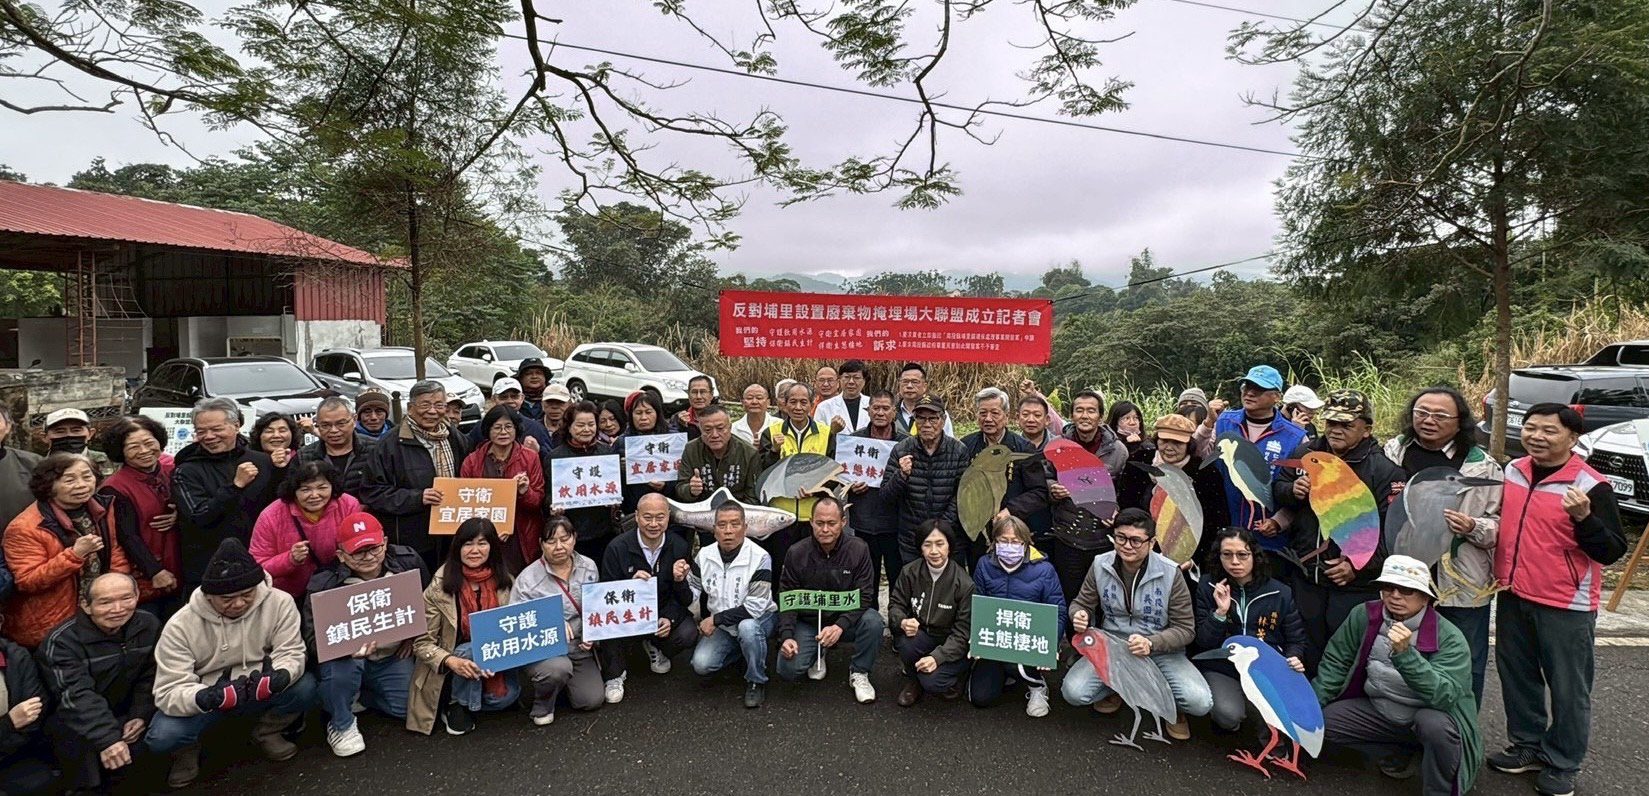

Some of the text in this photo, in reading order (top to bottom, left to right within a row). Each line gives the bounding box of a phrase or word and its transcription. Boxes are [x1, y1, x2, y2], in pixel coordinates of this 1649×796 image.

[733, 302, 1042, 326] 反對埔里設置廢棄物掩埋場大聯盟成立記者會
[735, 326, 759, 335] 我們的
[769, 327, 813, 337] 守護飲用水源
[866, 329, 889, 338] 我們的
[743, 336, 767, 348] 堅持
[873, 339, 897, 351] 訴求
[645, 441, 670, 455] 守衛
[854, 443, 880, 459] 捍衛
[572, 465, 602, 480] 守護
[458, 487, 493, 504] 守衛
[558, 480, 618, 498] 飲用水源
[438, 505, 507, 523] 宜居家園
[353, 521, 366, 533] N
[346, 587, 391, 616] 保衛
[604, 588, 636, 605] 保衛
[784, 592, 856, 607] 守護埔里水
[498, 609, 539, 634] 守護
[588, 605, 653, 627] 鎮民生計
[996, 608, 1032, 630] 捍衛
[325, 604, 416, 646] 鎮民生計
[480, 626, 559, 662] 飲用水源
[978, 627, 1049, 655] 生態棲地
